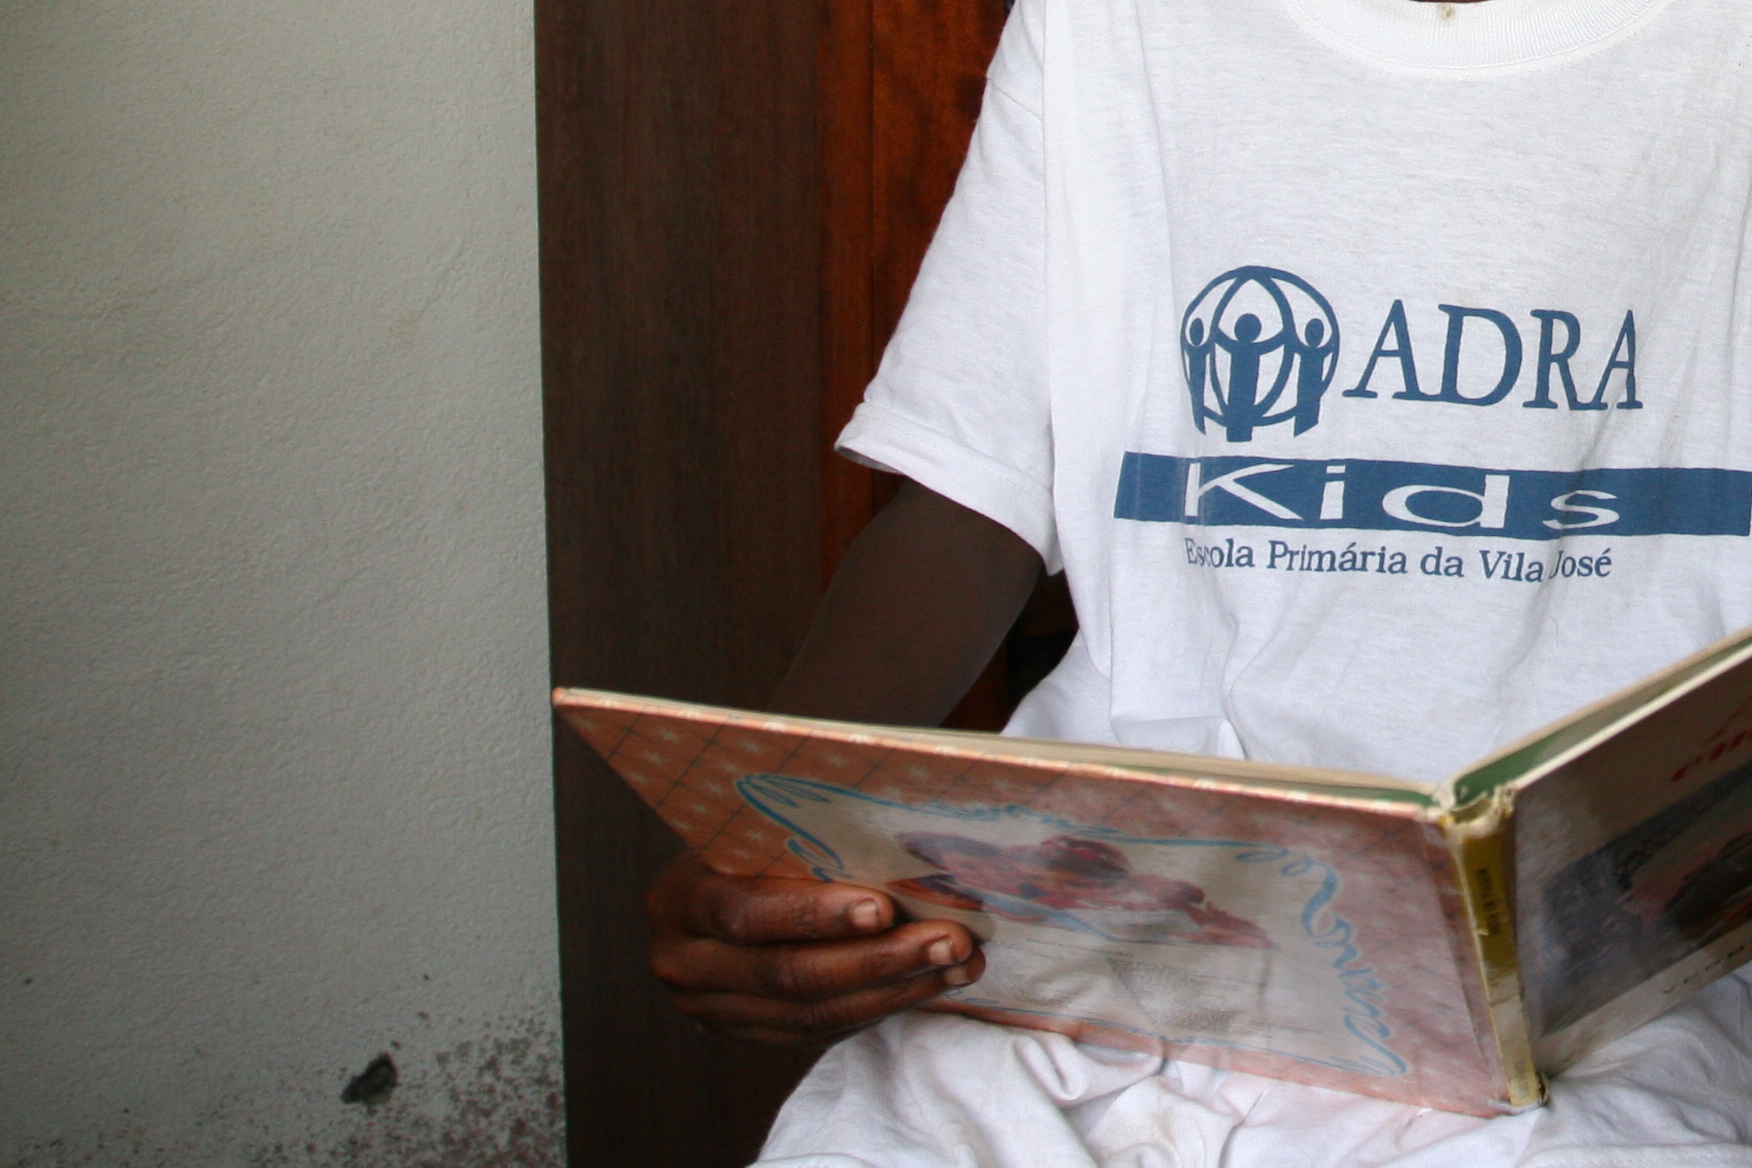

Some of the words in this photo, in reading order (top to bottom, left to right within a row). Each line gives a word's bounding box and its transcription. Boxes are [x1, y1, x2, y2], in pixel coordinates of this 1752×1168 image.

[1342, 298, 1645, 412] ADRA
[1184, 462, 1620, 530] Kids
[1184, 537, 1255, 569] Escola
[1267, 540, 1408, 575] Primária
[1420, 546, 1465, 578] da
[1478, 549, 1545, 584] Vila
[1548, 546, 1613, 580] José
